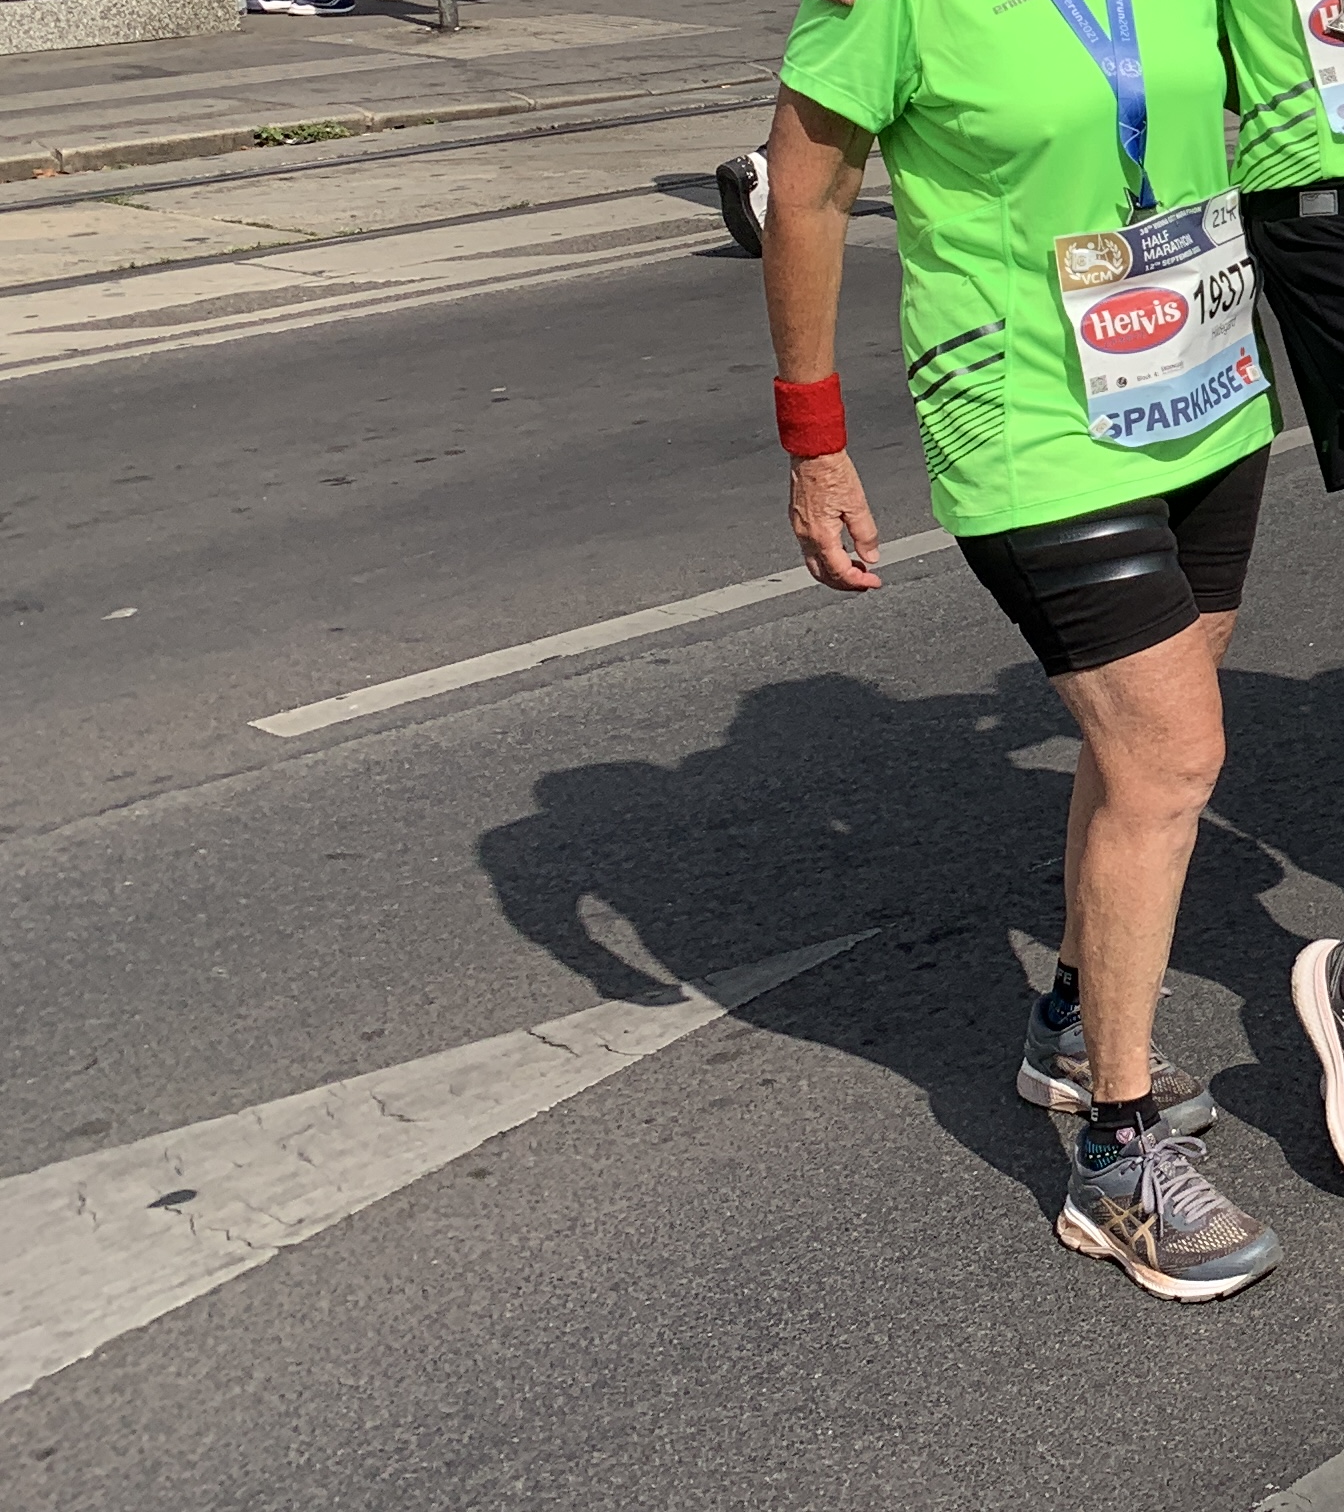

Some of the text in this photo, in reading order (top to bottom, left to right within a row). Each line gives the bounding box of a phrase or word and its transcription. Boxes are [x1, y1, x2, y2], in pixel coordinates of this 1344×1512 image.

[1142, 230, 1169, 250] HALF
[1144, 233, 1194, 262] MARATHON
[1082, 270, 1114, 285] VCM
[1089, 299, 1182, 341] Hervis
[1107, 367, 1243, 439] SPARKASSE
